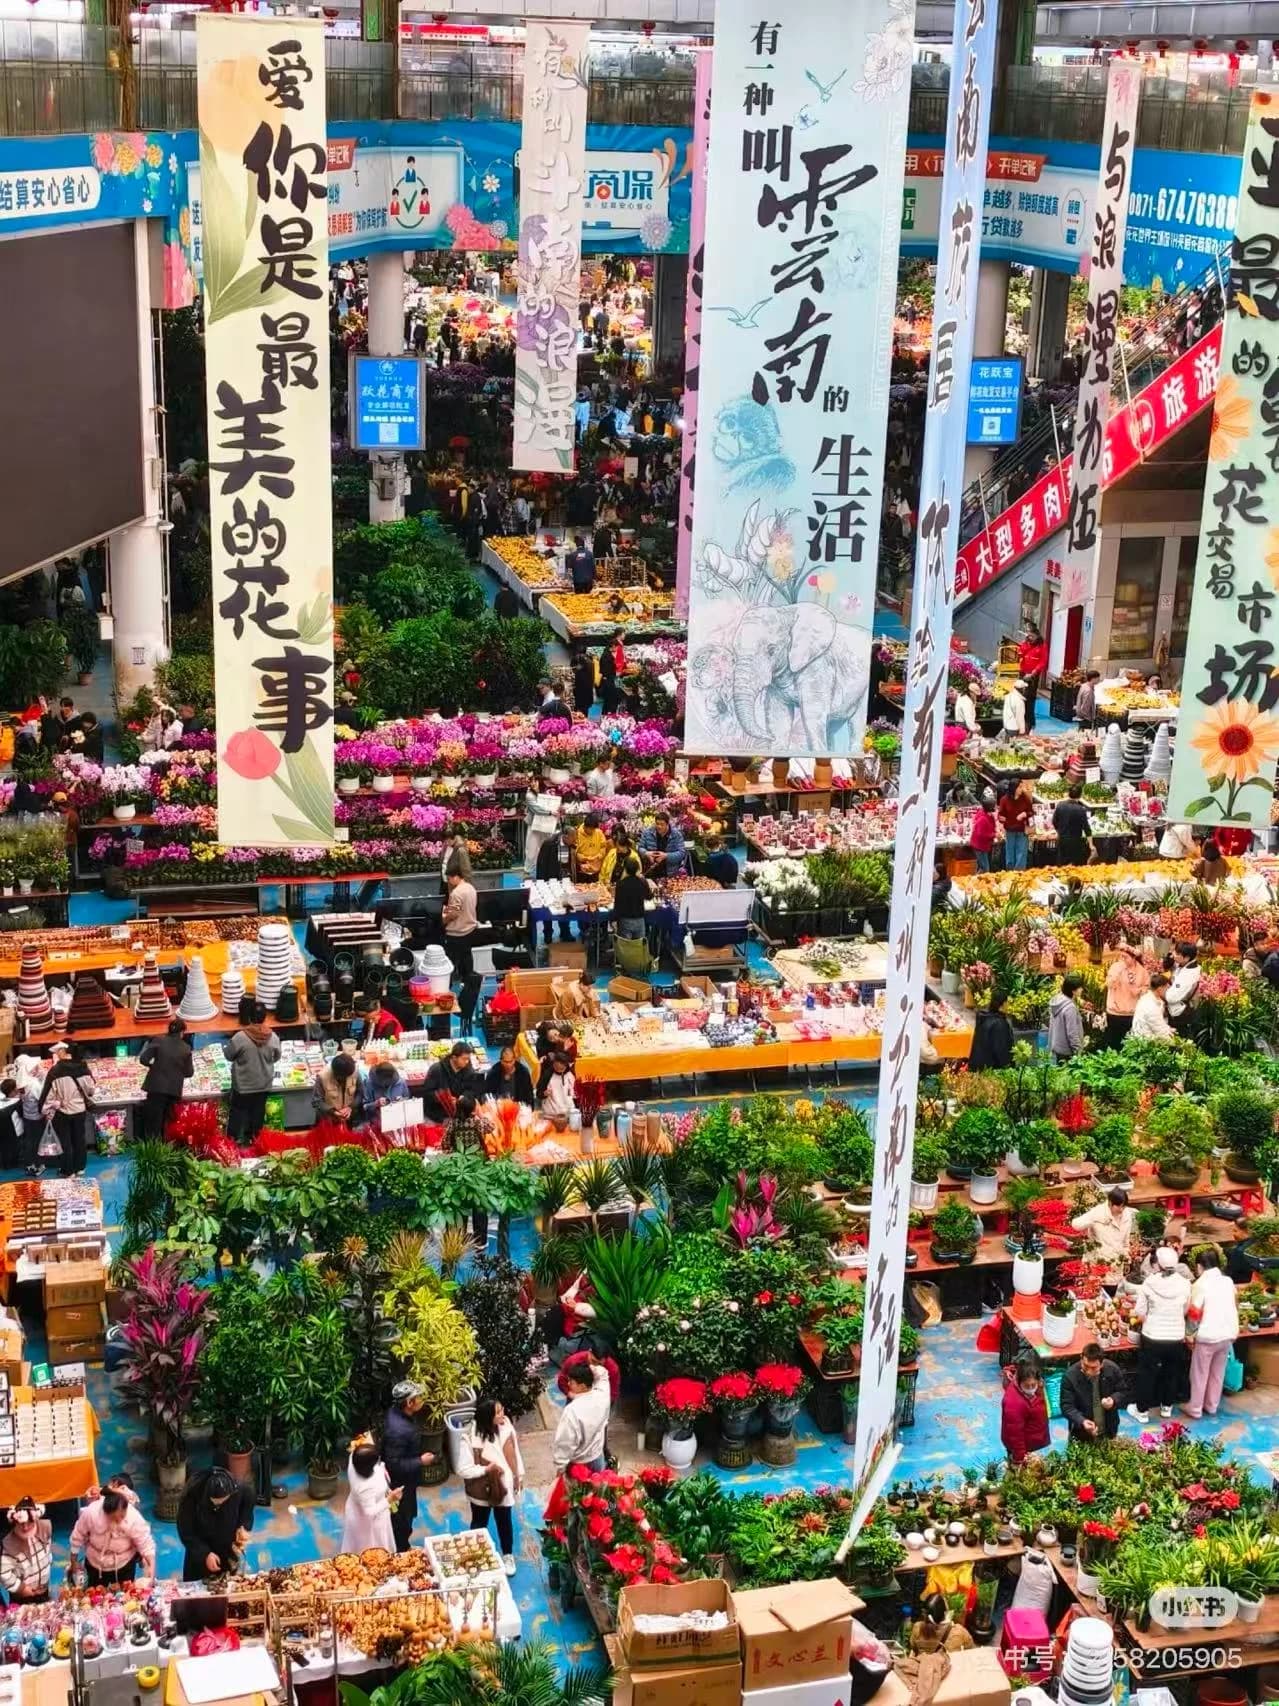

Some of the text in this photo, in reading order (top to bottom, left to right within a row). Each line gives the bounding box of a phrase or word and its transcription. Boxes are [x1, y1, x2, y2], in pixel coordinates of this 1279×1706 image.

[0, 174, 90, 211] 结算安心省心
[210, 39, 334, 753] 爱你是最美的花事
[1068, 121, 1131, 556] 与浪漫为伍
[1161, 346, 1219, 428] 旅游
